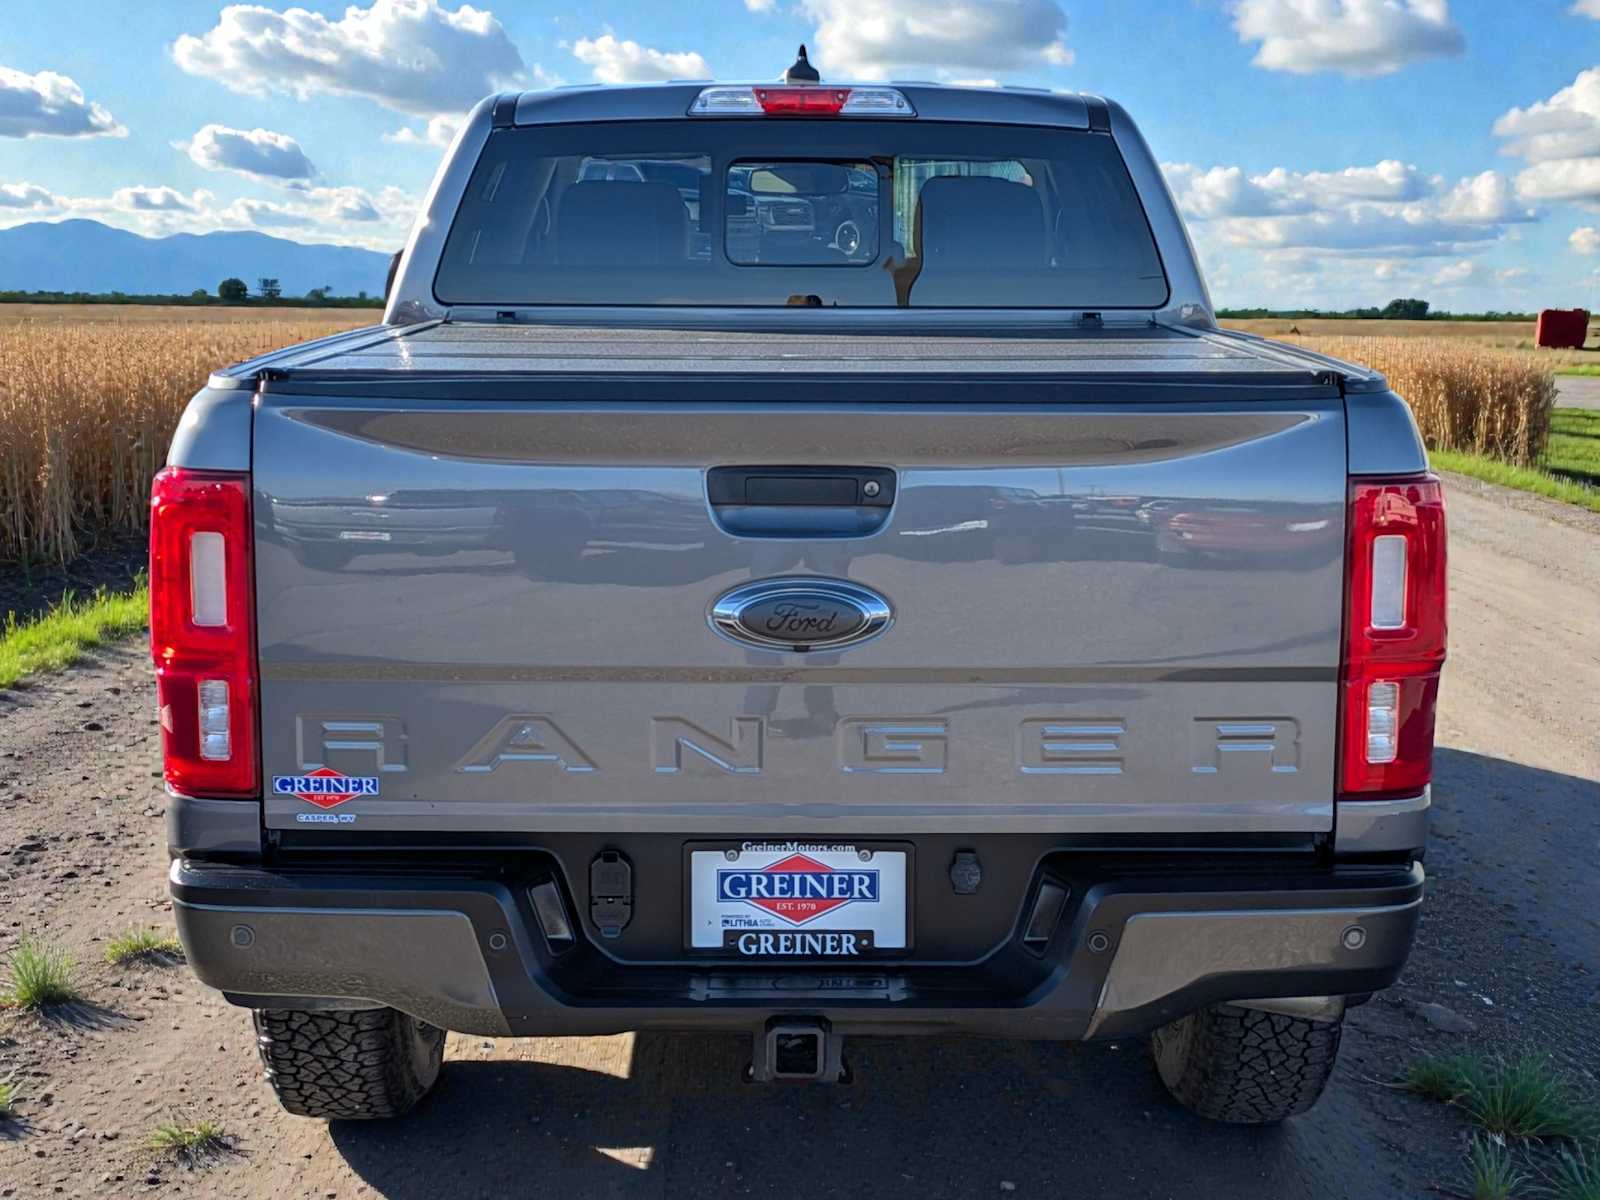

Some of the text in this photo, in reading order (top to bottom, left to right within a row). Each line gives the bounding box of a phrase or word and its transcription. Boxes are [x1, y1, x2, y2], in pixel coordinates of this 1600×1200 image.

[765, 602, 840, 633] Ford
[295, 713, 1302, 775] RANGER
[275, 777, 376, 793] GREINER
[741, 841, 856, 852] GreinerMotors.com
[723, 873, 874, 899] GREINER
[776, 902, 817, 912] EST. 1970
[738, 933, 859, 955] GREINER
